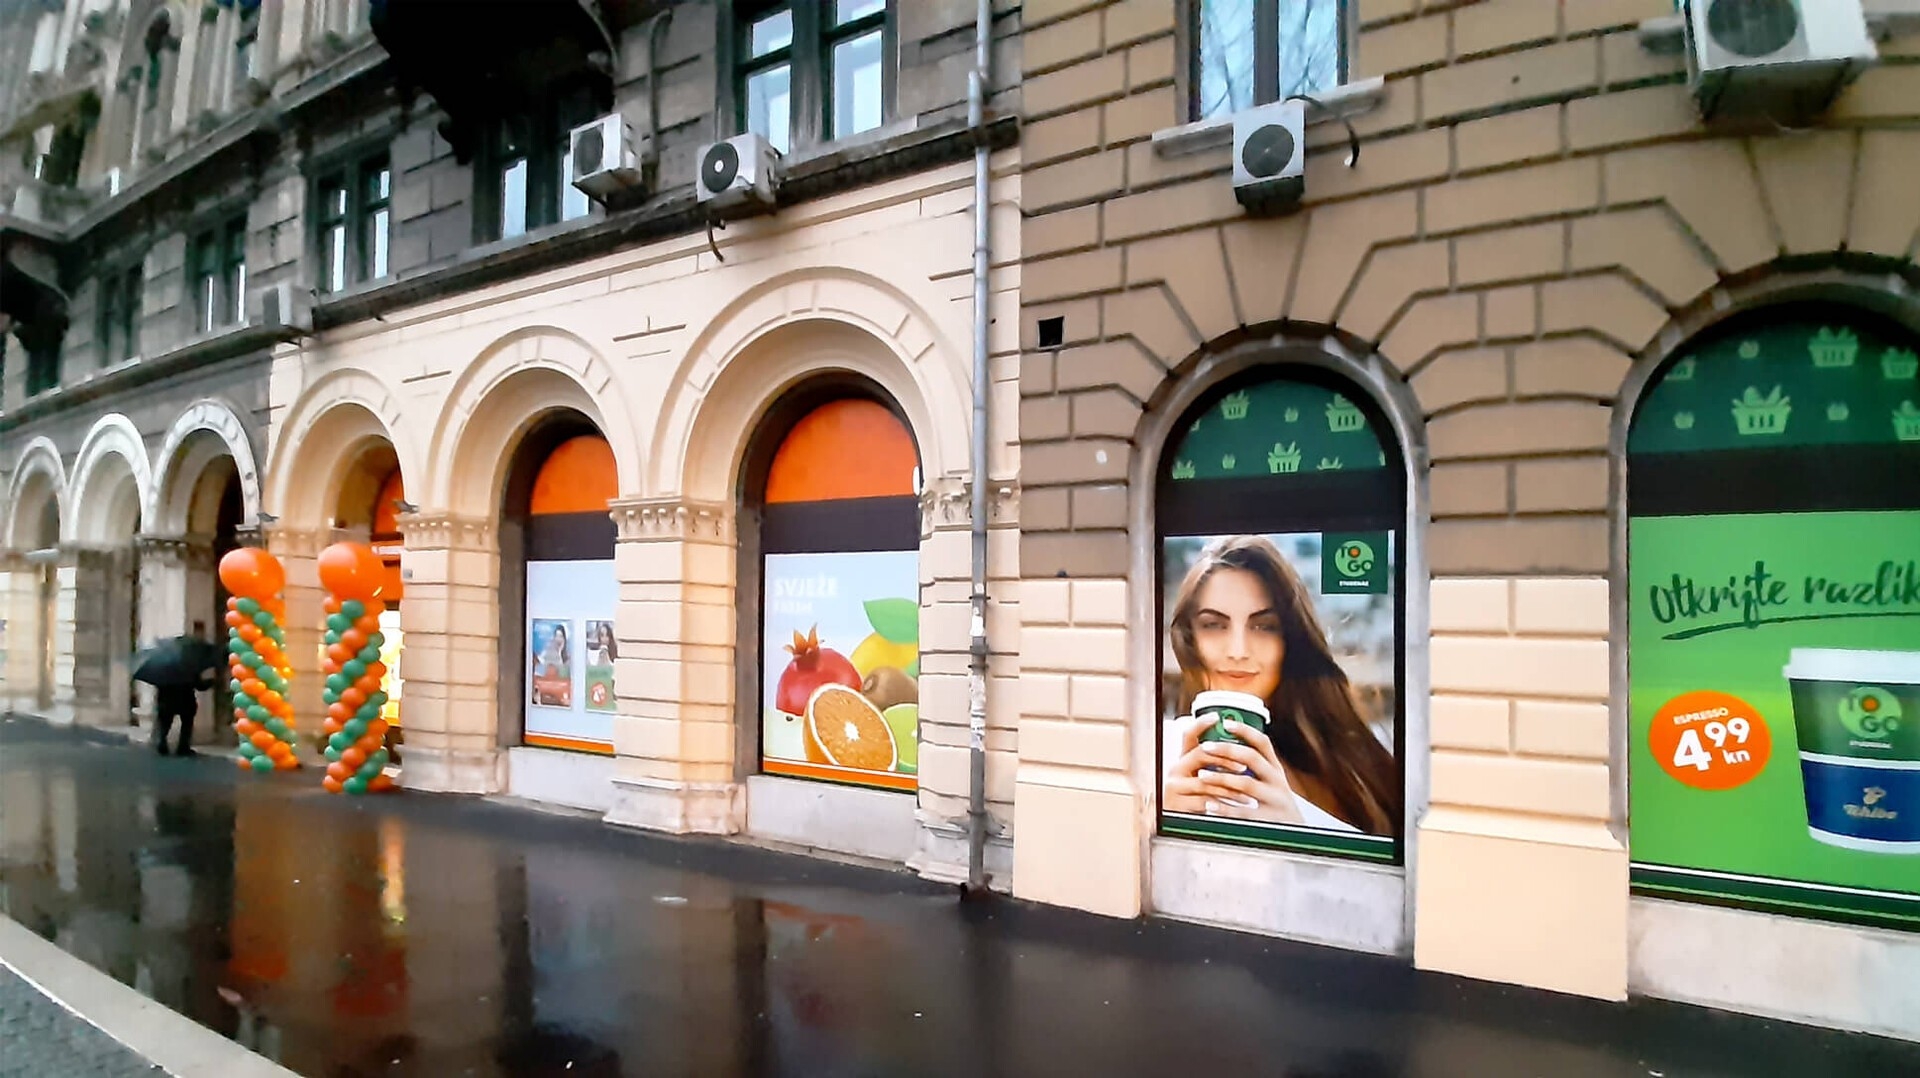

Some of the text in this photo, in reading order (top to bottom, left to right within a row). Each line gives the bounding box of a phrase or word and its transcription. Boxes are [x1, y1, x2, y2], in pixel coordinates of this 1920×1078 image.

[1348, 560, 1373, 572] GO
[1649, 561, 1790, 629] Otkrijte
[1722, 749, 1751, 764] kn
